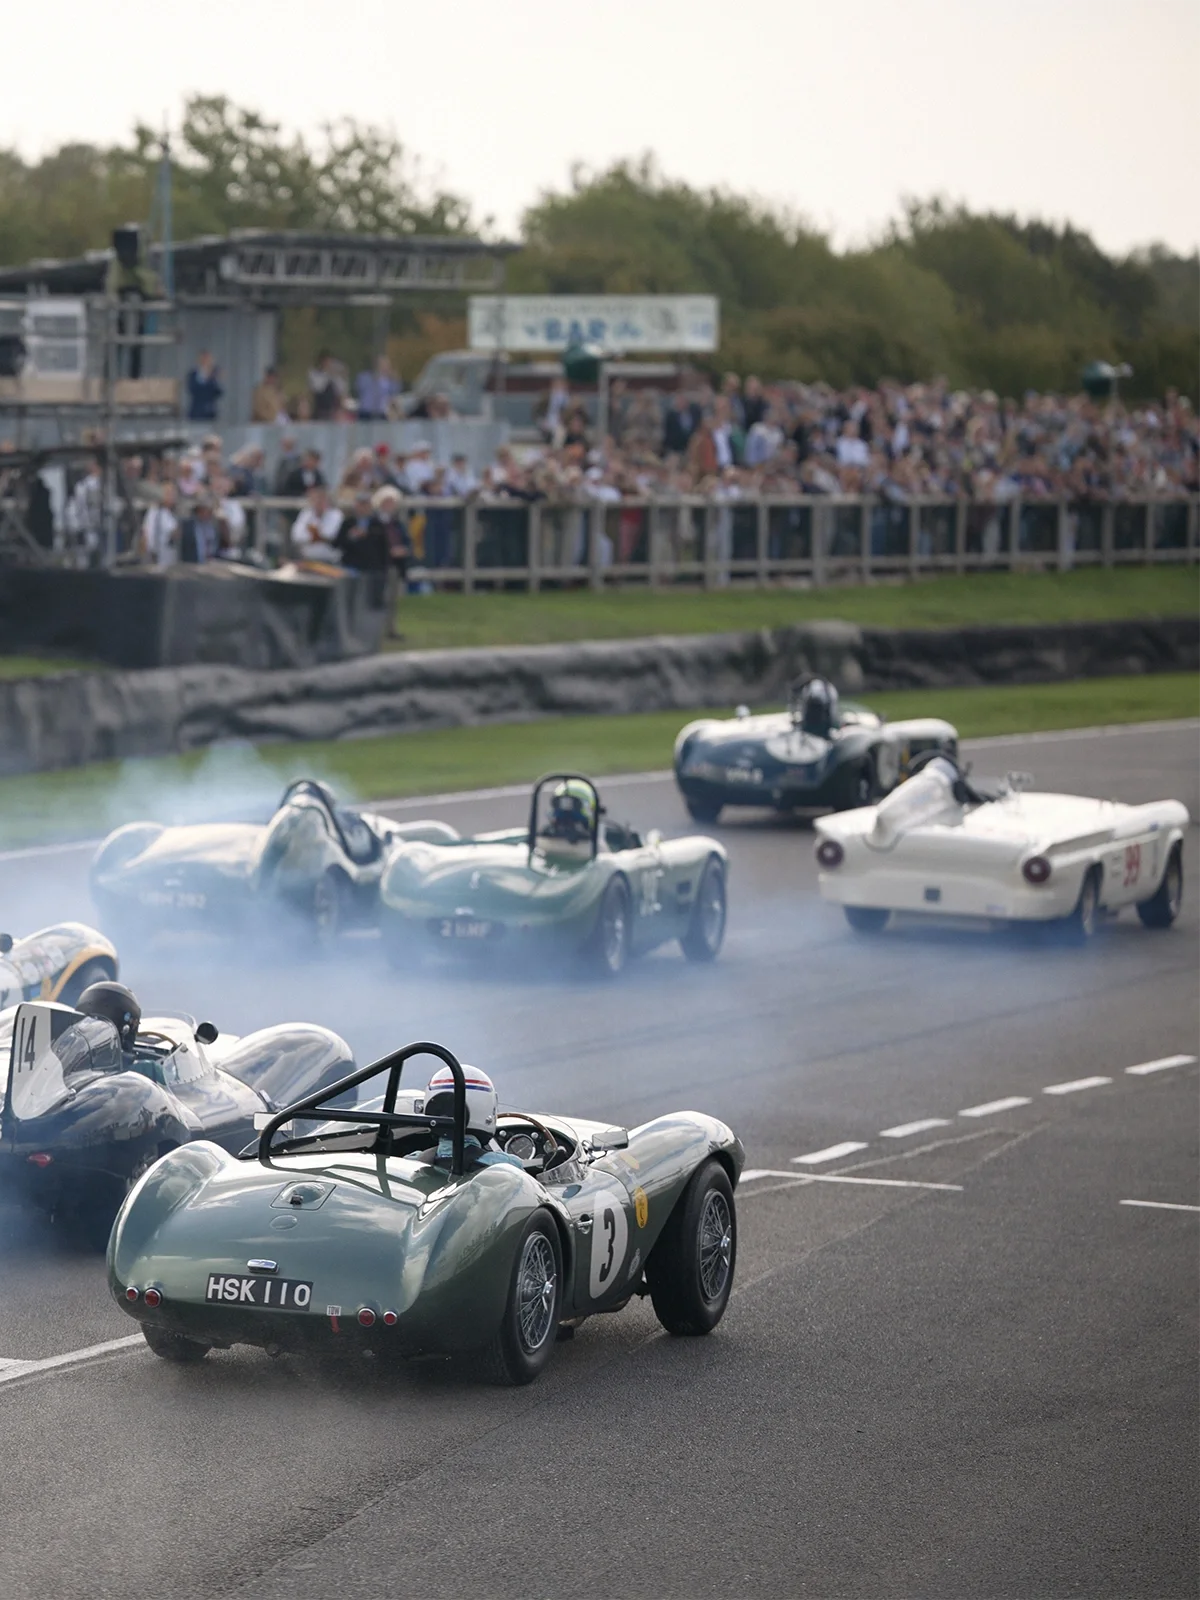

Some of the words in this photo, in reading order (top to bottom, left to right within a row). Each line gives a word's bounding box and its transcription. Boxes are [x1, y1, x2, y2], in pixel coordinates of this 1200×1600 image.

[18, 1016, 37, 1073] 14
[599, 1207, 615, 1283] 3
[207, 1276, 256, 1303] HSK
[264, 1280, 311, 1307] 110
